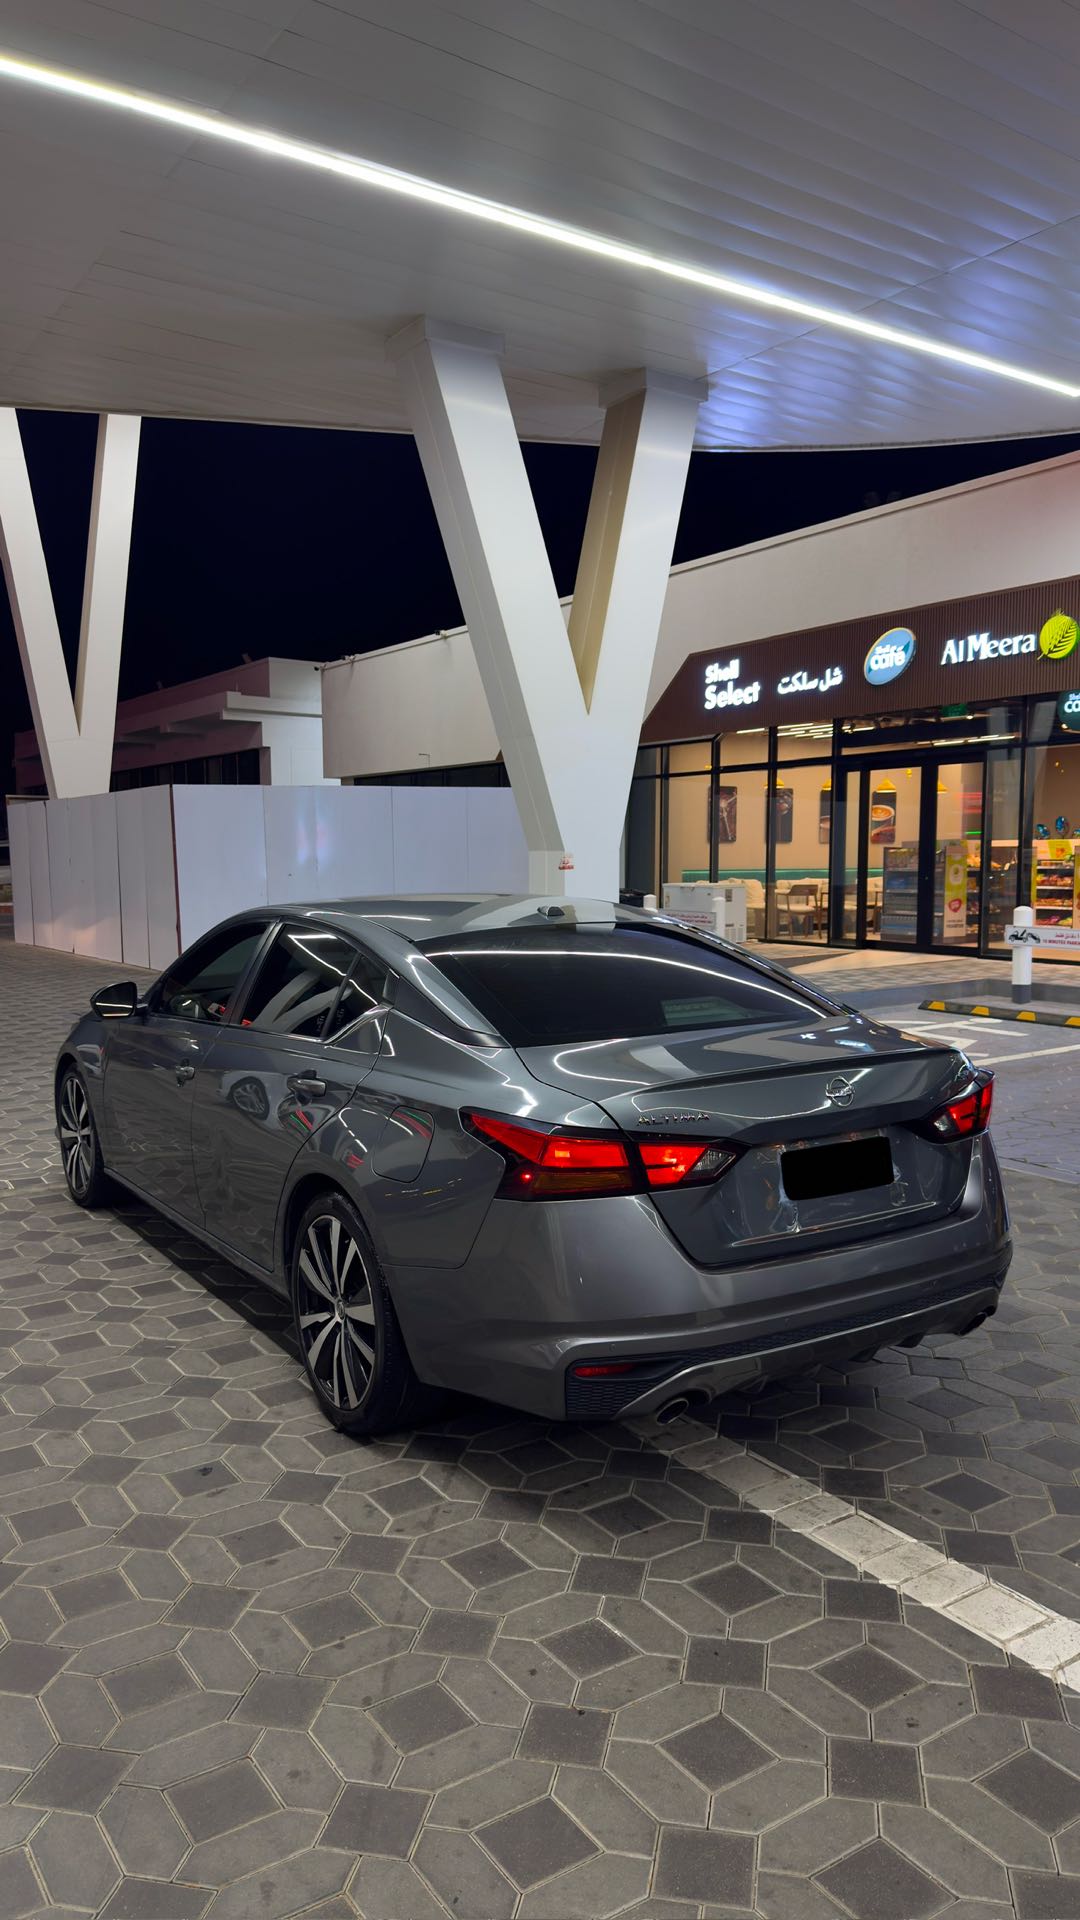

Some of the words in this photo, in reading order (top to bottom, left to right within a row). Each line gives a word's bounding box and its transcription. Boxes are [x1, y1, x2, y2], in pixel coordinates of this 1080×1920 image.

[941, 639, 964, 666] Al
[966, 632, 1036, 662] Meera
[705, 658, 739, 684] Shell
[818, 666, 843, 692] شل
[704, 680, 760, 710] Select
[1064, 700, 1080, 713] ca
[637, 1112, 710, 1126] ALTIMA
